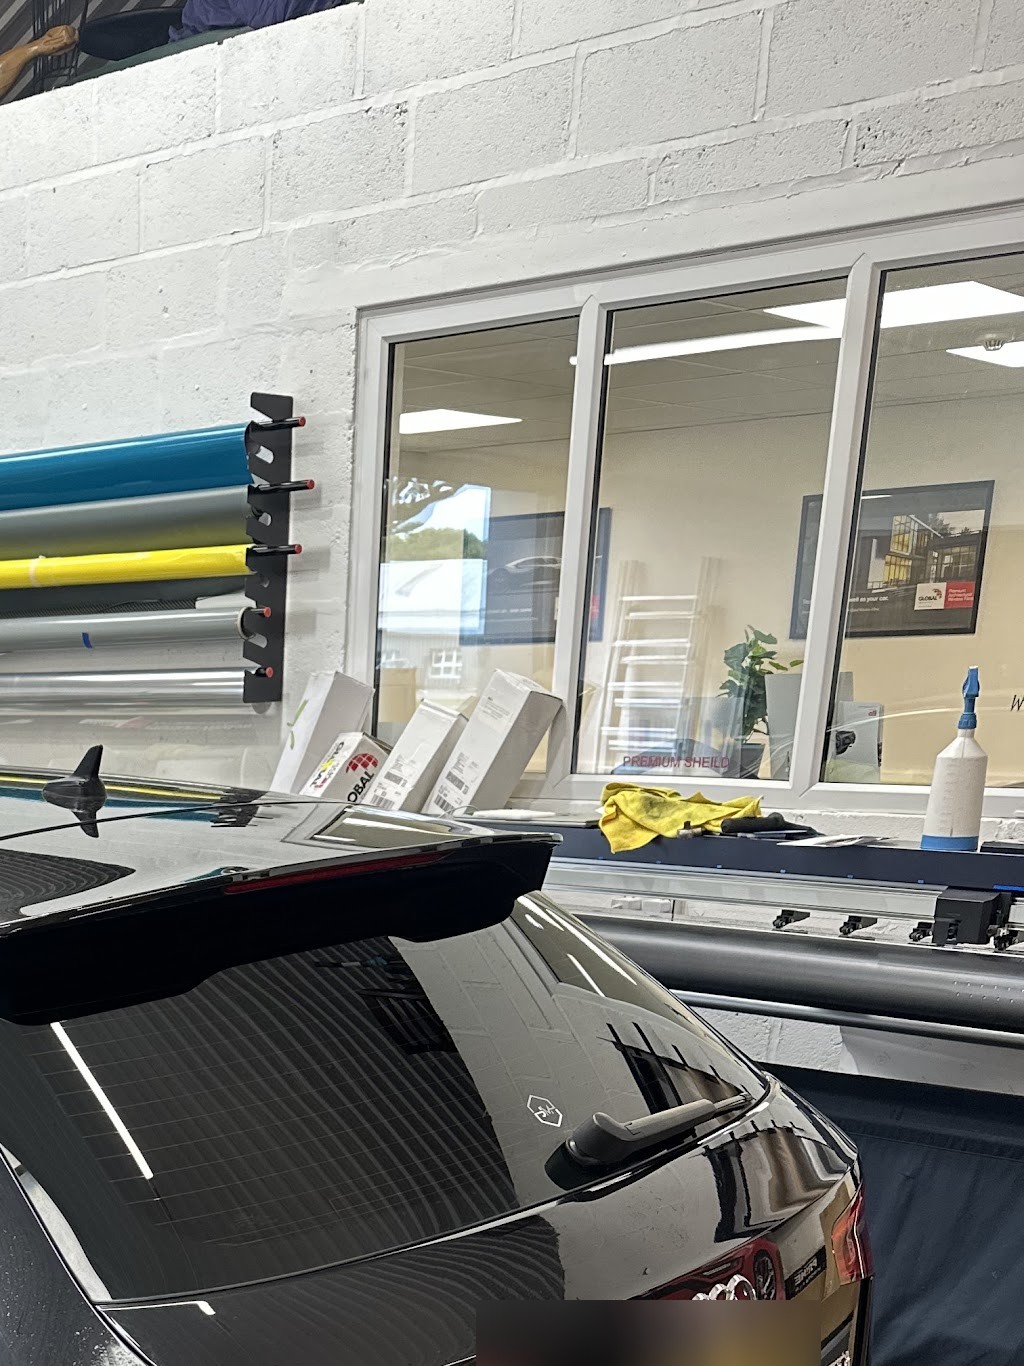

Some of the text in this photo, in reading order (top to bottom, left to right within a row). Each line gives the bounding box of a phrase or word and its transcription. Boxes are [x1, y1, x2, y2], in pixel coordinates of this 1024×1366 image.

[623, 756, 730, 769] PREMIUM SHEILD
[347, 771, 375, 803] OBAL
